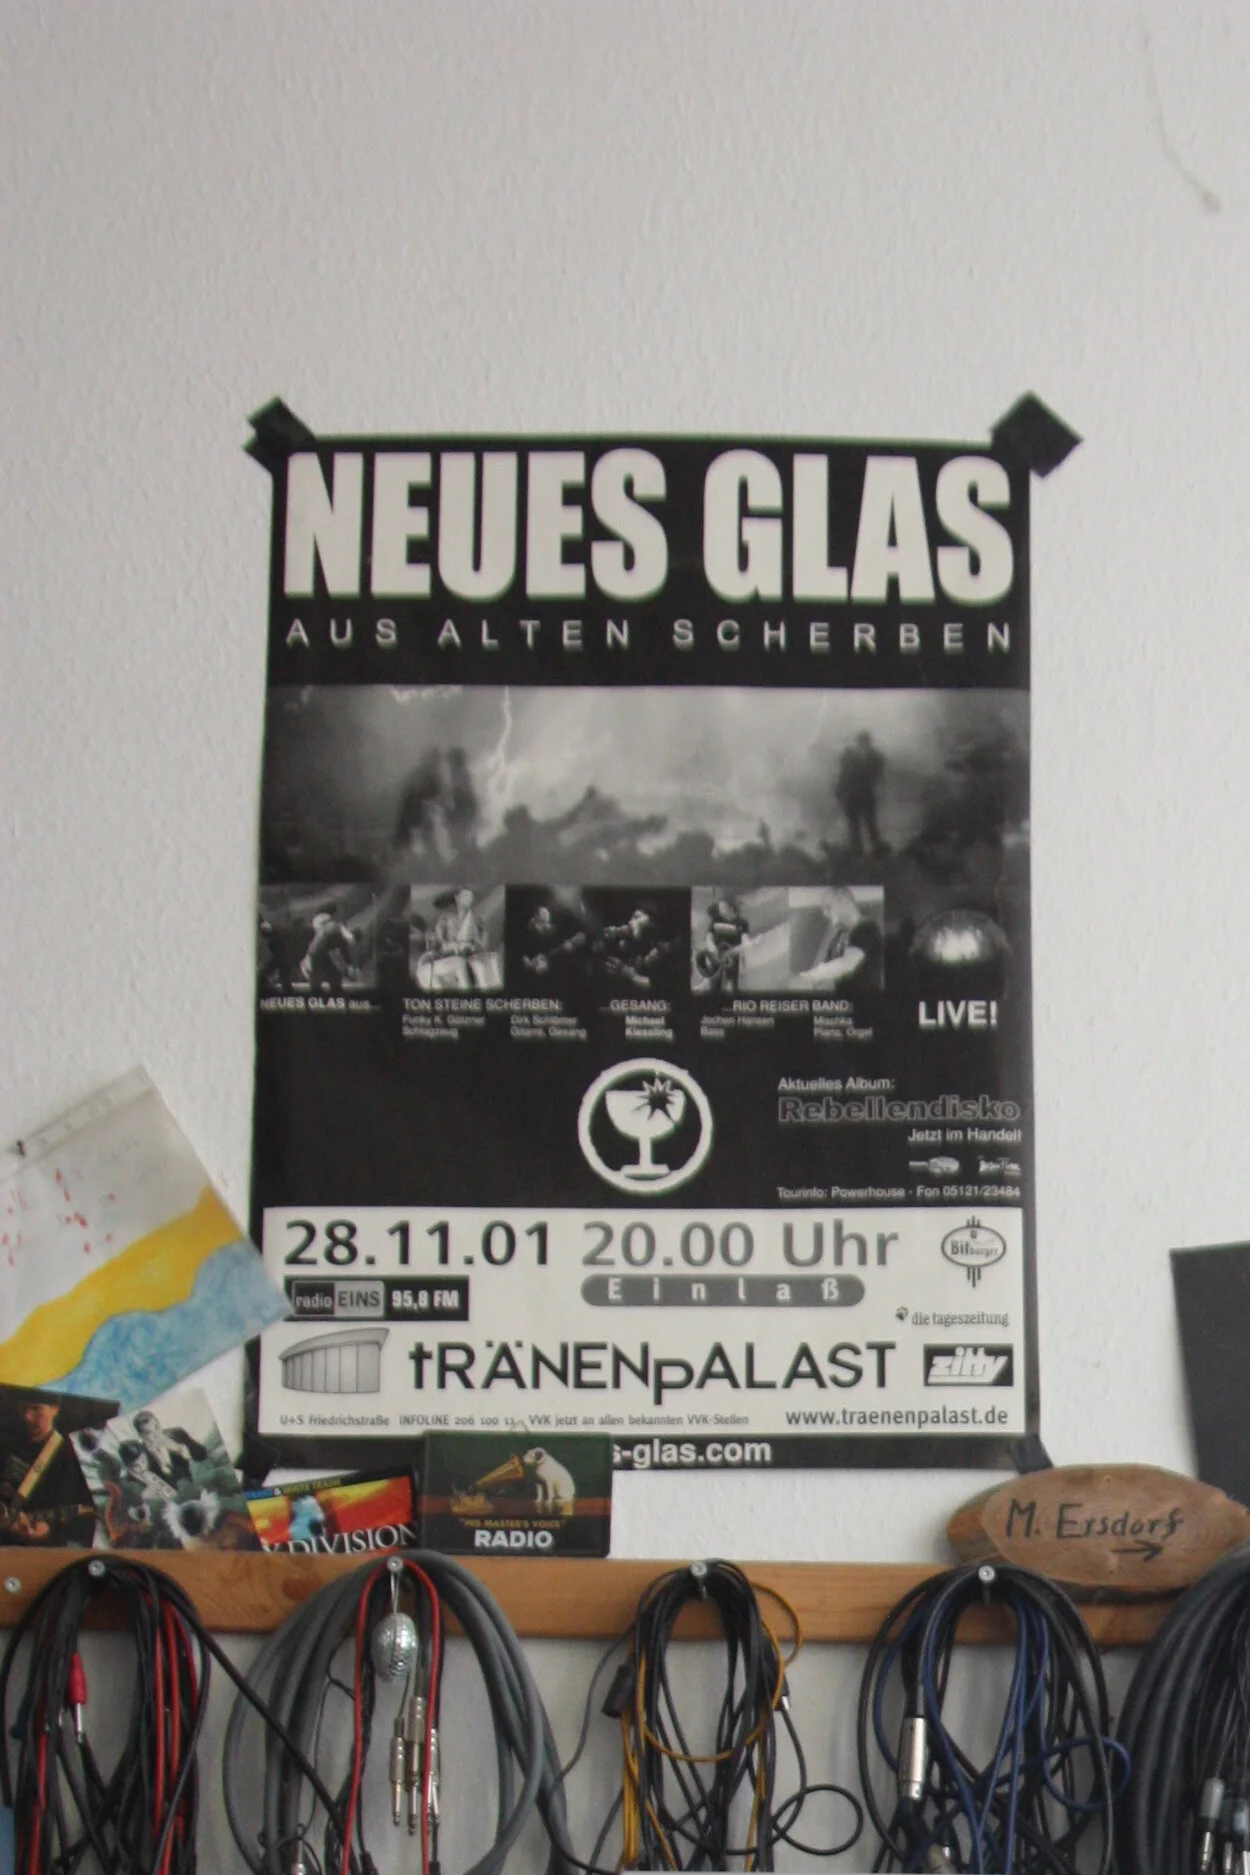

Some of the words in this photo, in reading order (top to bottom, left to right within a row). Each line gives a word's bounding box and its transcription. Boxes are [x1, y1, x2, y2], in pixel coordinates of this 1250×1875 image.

[283, 448, 669, 599] NEUES
[703, 449, 1015, 602] GLAS
[284, 618, 397, 648] AUS
[437, 619, 631, 650] ALTEN
[673, 619, 1012, 651] SCHERBEN
[260, 996, 305, 1009] NEUES
[308, 997, 345, 1010] GLAS
[403, 998, 431, 1010] TON
[434, 998, 481, 1010] STEINE
[760, 1000, 809, 1012] REISER
[919, 1001, 998, 1026] LIVE!
[778, 1077, 841, 1090] Aktuelles
[846, 1077, 895, 1090] Album:
[778, 1095, 1020, 1121] Rebellendisko
[908, 1128, 942, 1141] Jetzt
[946, 1128, 963, 1141] im
[831, 1186, 905, 1198] Powerhouse
[916, 1186, 940, 1197] Fon
[284, 1219, 548, 1266] 28.11.01
[581, 1220, 754, 1267] 20.00
[783, 1219, 899, 1267] Uhr
[337, 1290, 381, 1308] EINS
[391, 1289, 428, 1310] 95,8
[433, 1289, 460, 1309] FM
[911, 1311, 929, 1325] die
[933, 1311, 1009, 1327] tageszeitung
[309, 1414, 389, 1426] Friedrichstraße
[399, 1414, 449, 1425] INFOLINE
[599, 1414, 624, 1425] allen
[629, 1414, 683, 1425] bekannten
[786, 1405, 1008, 1429] www.traenenpalast.de
[1005, 1498, 1040, 1538] M.
[474, 1530, 553, 1548] RADIO
